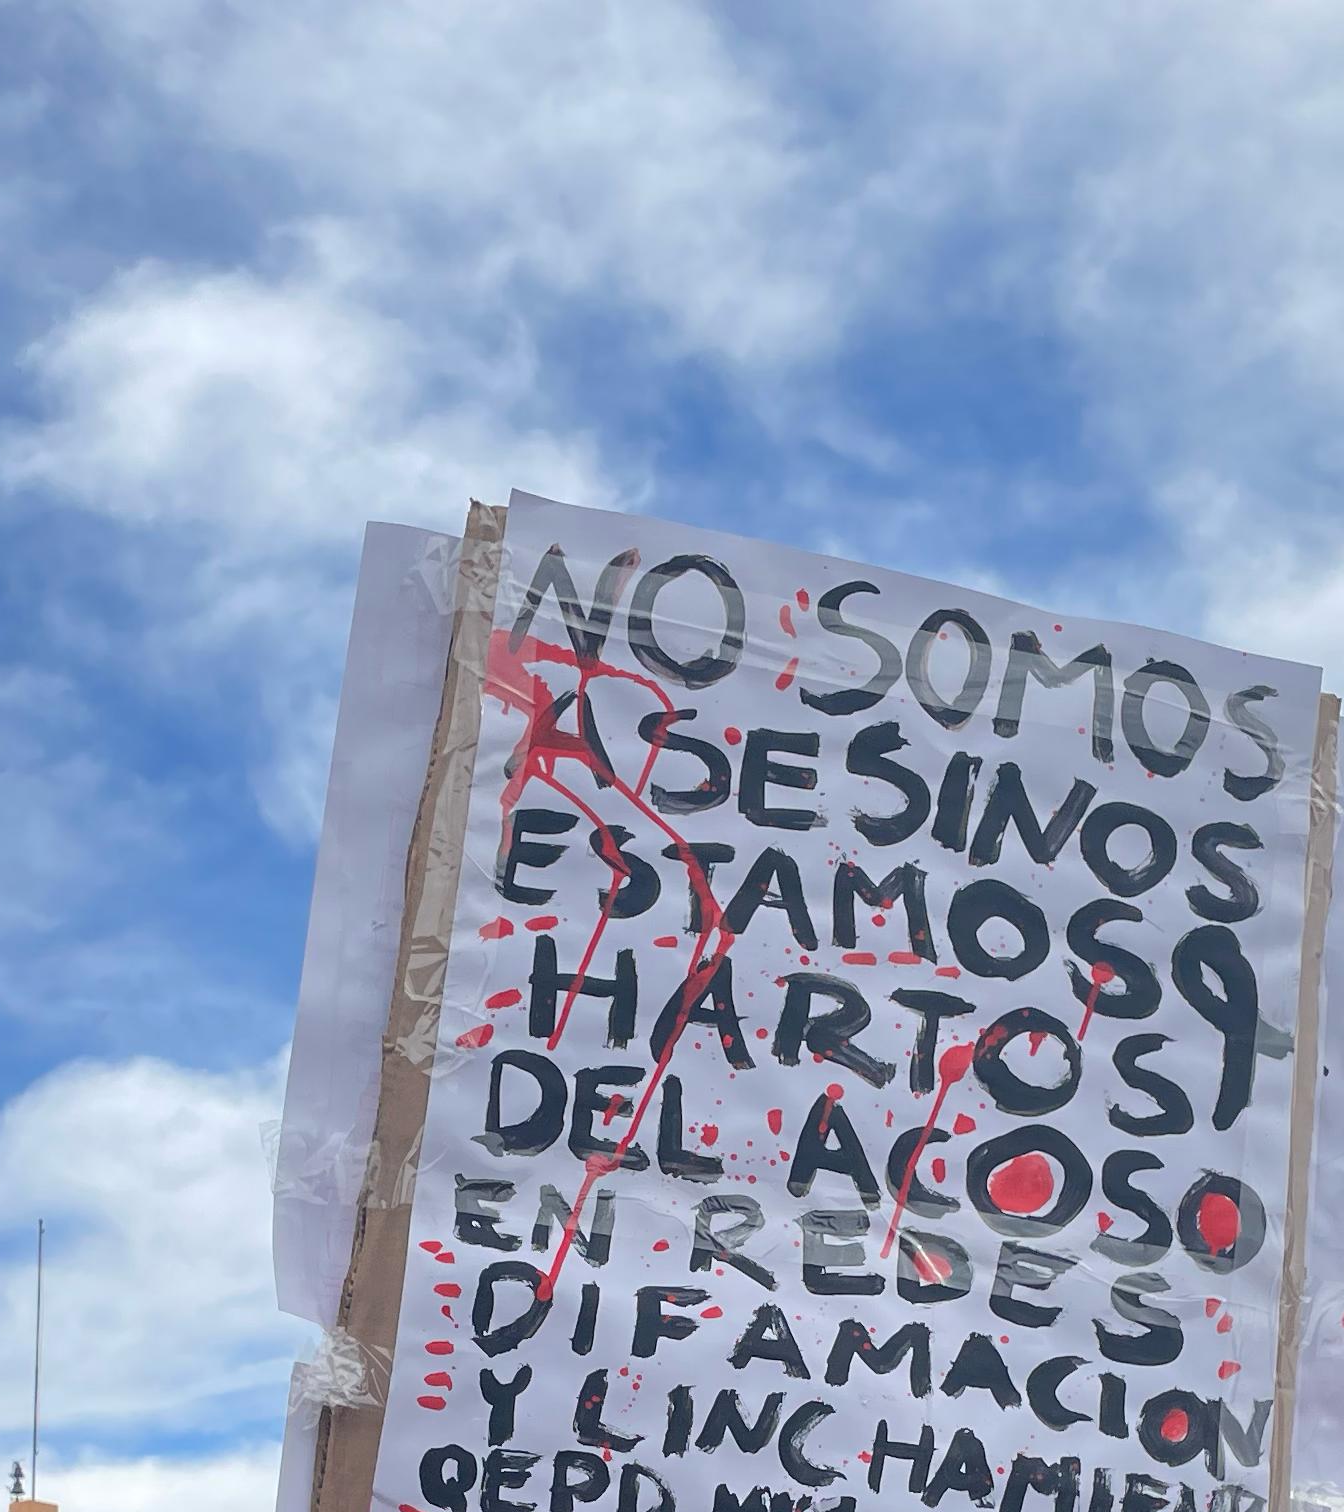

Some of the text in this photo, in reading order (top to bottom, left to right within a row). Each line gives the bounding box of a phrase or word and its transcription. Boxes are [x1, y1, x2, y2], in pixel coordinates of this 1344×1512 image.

[508, 543, 1287, 801] NO SOMOS
[496, 808, 1164, 1020] ESTAMOS
[504, 689, 1264, 923] ASESINOS
[528, 934, 1196, 1138] HARTOS
[455, 1172, 1185, 1365] EN REDES
[471, 1049, 1267, 1275] DEL ACOSO
[472, 1261, 1273, 1481] DIFAMACION
[480, 1364, 532, 1447] Y
